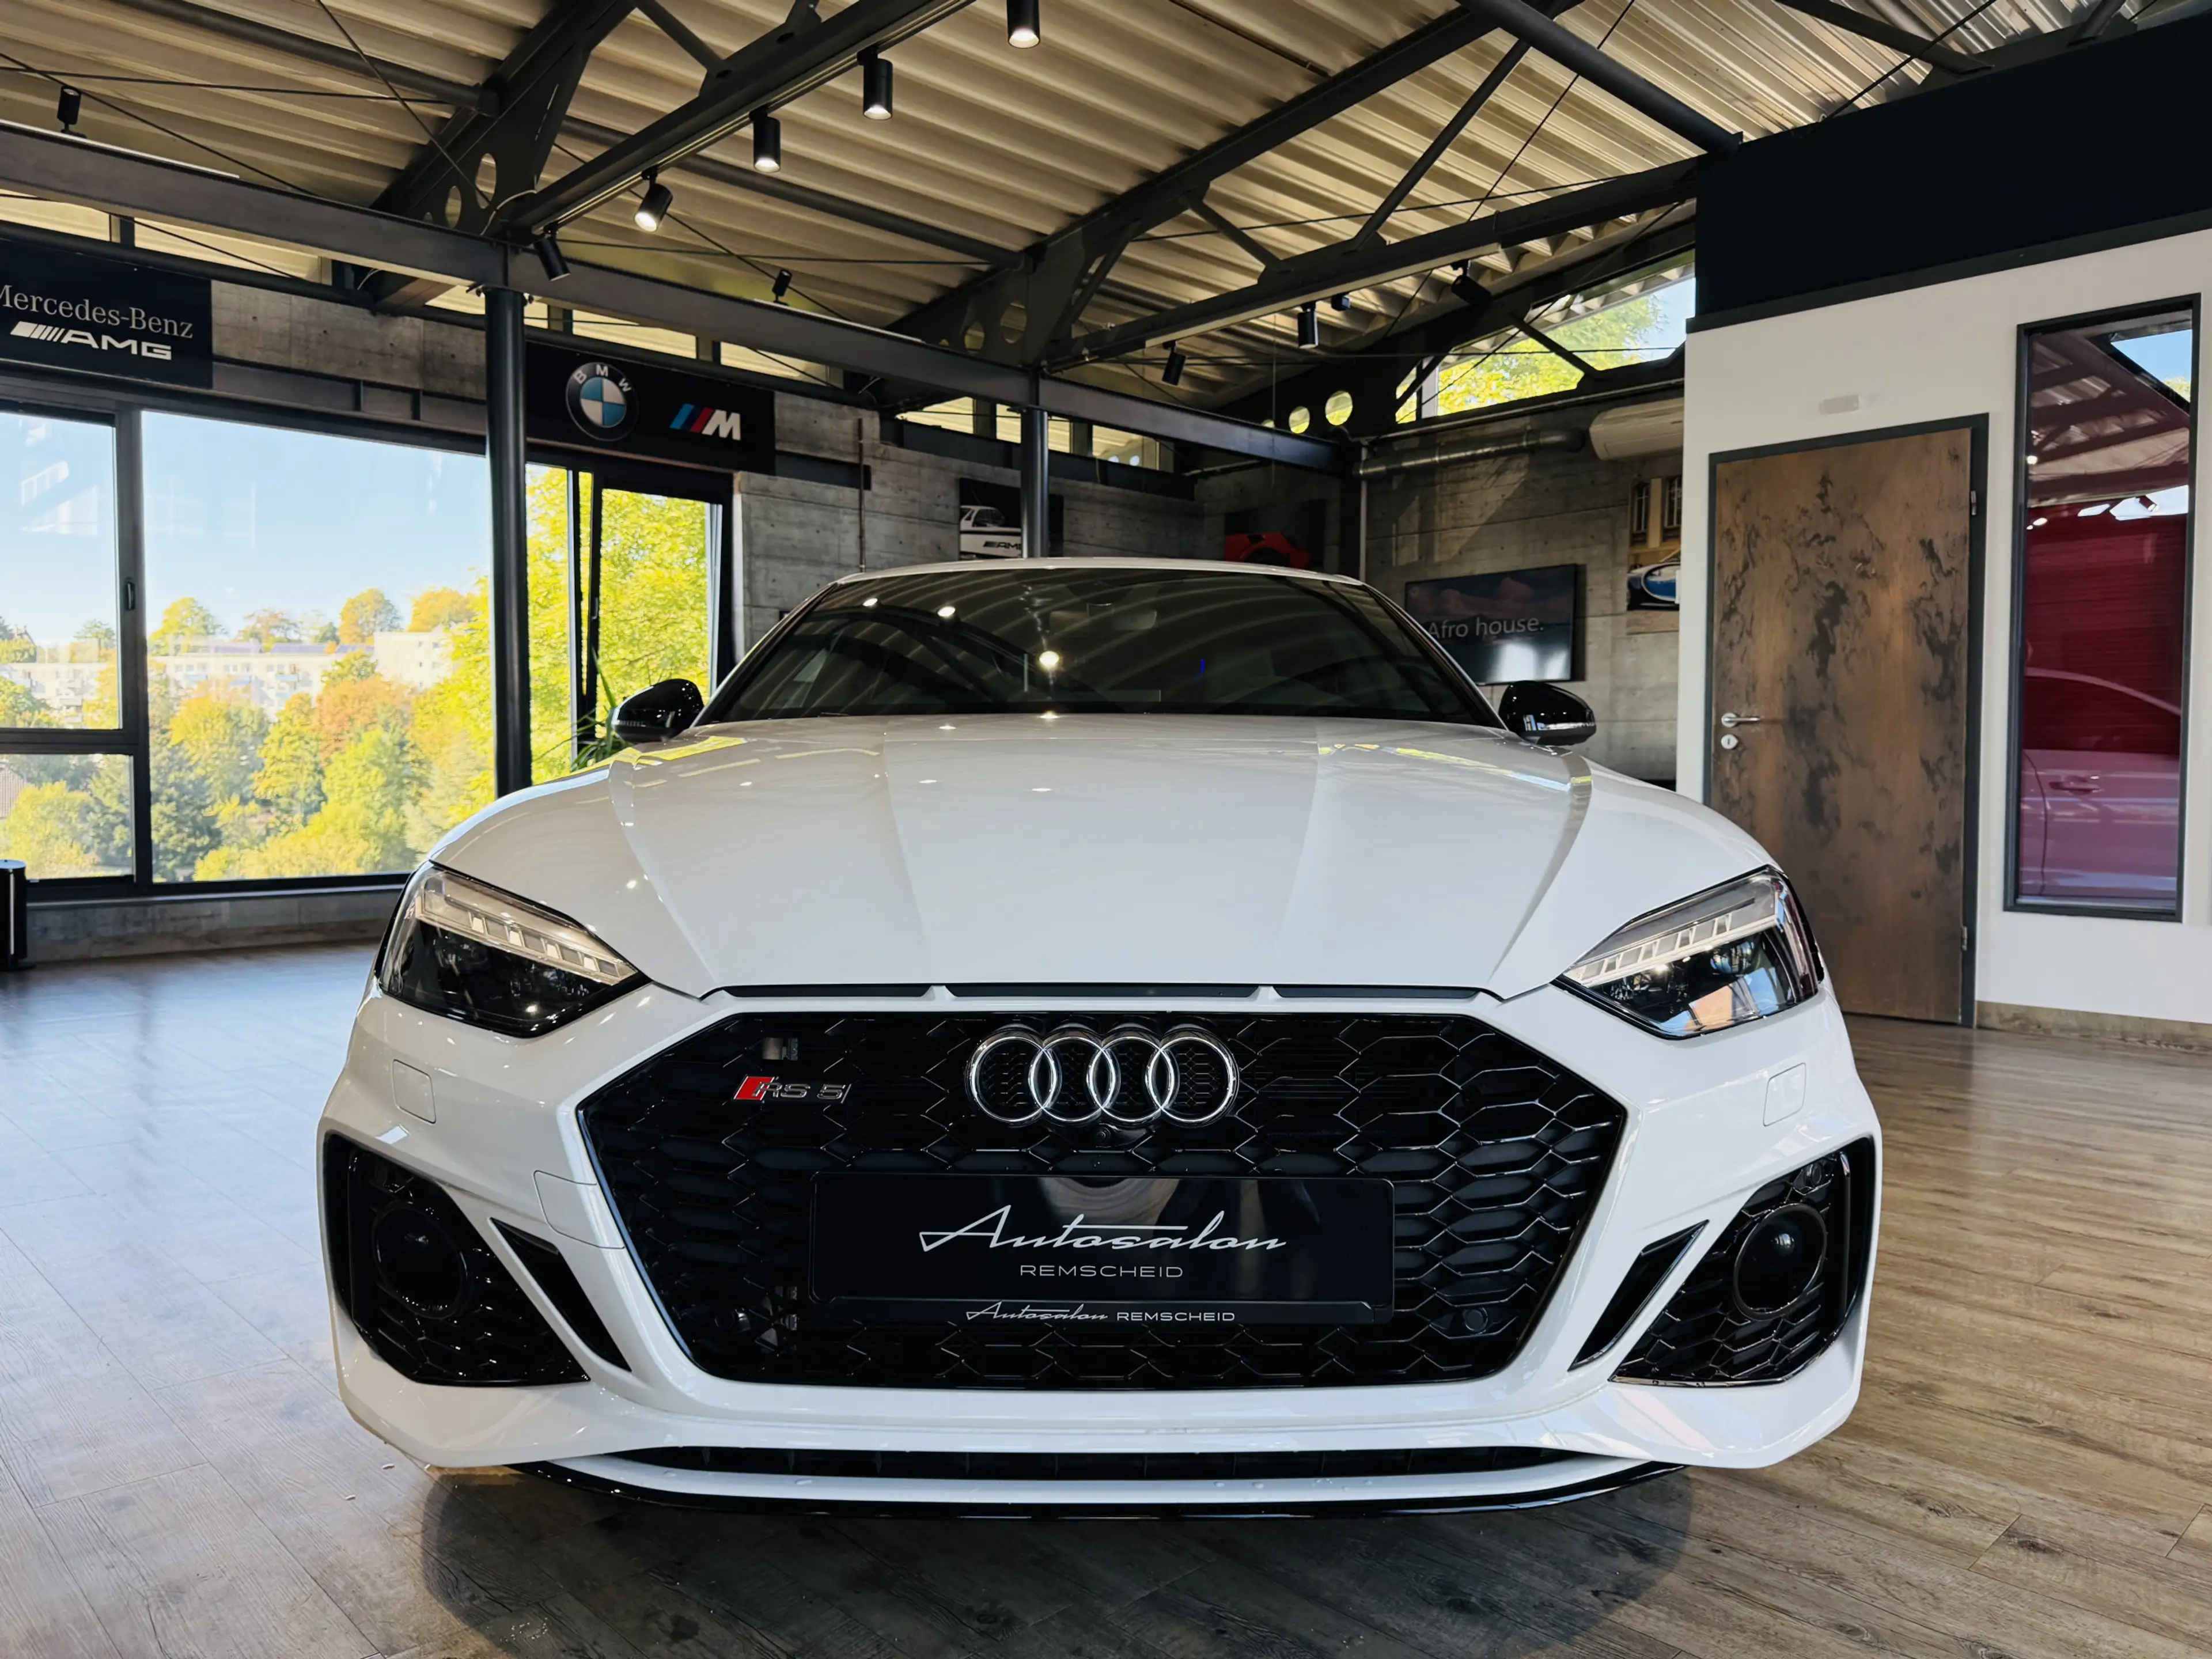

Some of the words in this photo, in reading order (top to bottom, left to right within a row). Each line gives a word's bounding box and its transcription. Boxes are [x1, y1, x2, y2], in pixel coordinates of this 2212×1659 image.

[60, 329, 172, 361] AMG
[573, 363, 632, 393] BMW
[701, 409, 741, 441] M
[997, 541, 1021, 550] AM
[1428, 619, 1468, 639] Afro
[1476, 617, 1544, 637] house.
[751, 1082, 811, 1099] RS
[816, 1084, 846, 1100] 5
[919, 1204, 1287, 1252] Autosalon
[1020, 1264, 1183, 1278] REMSCHEID
[965, 1300, 1109, 1321] Autosalon
[1116, 1311, 1236, 1322] REMSCHEID
